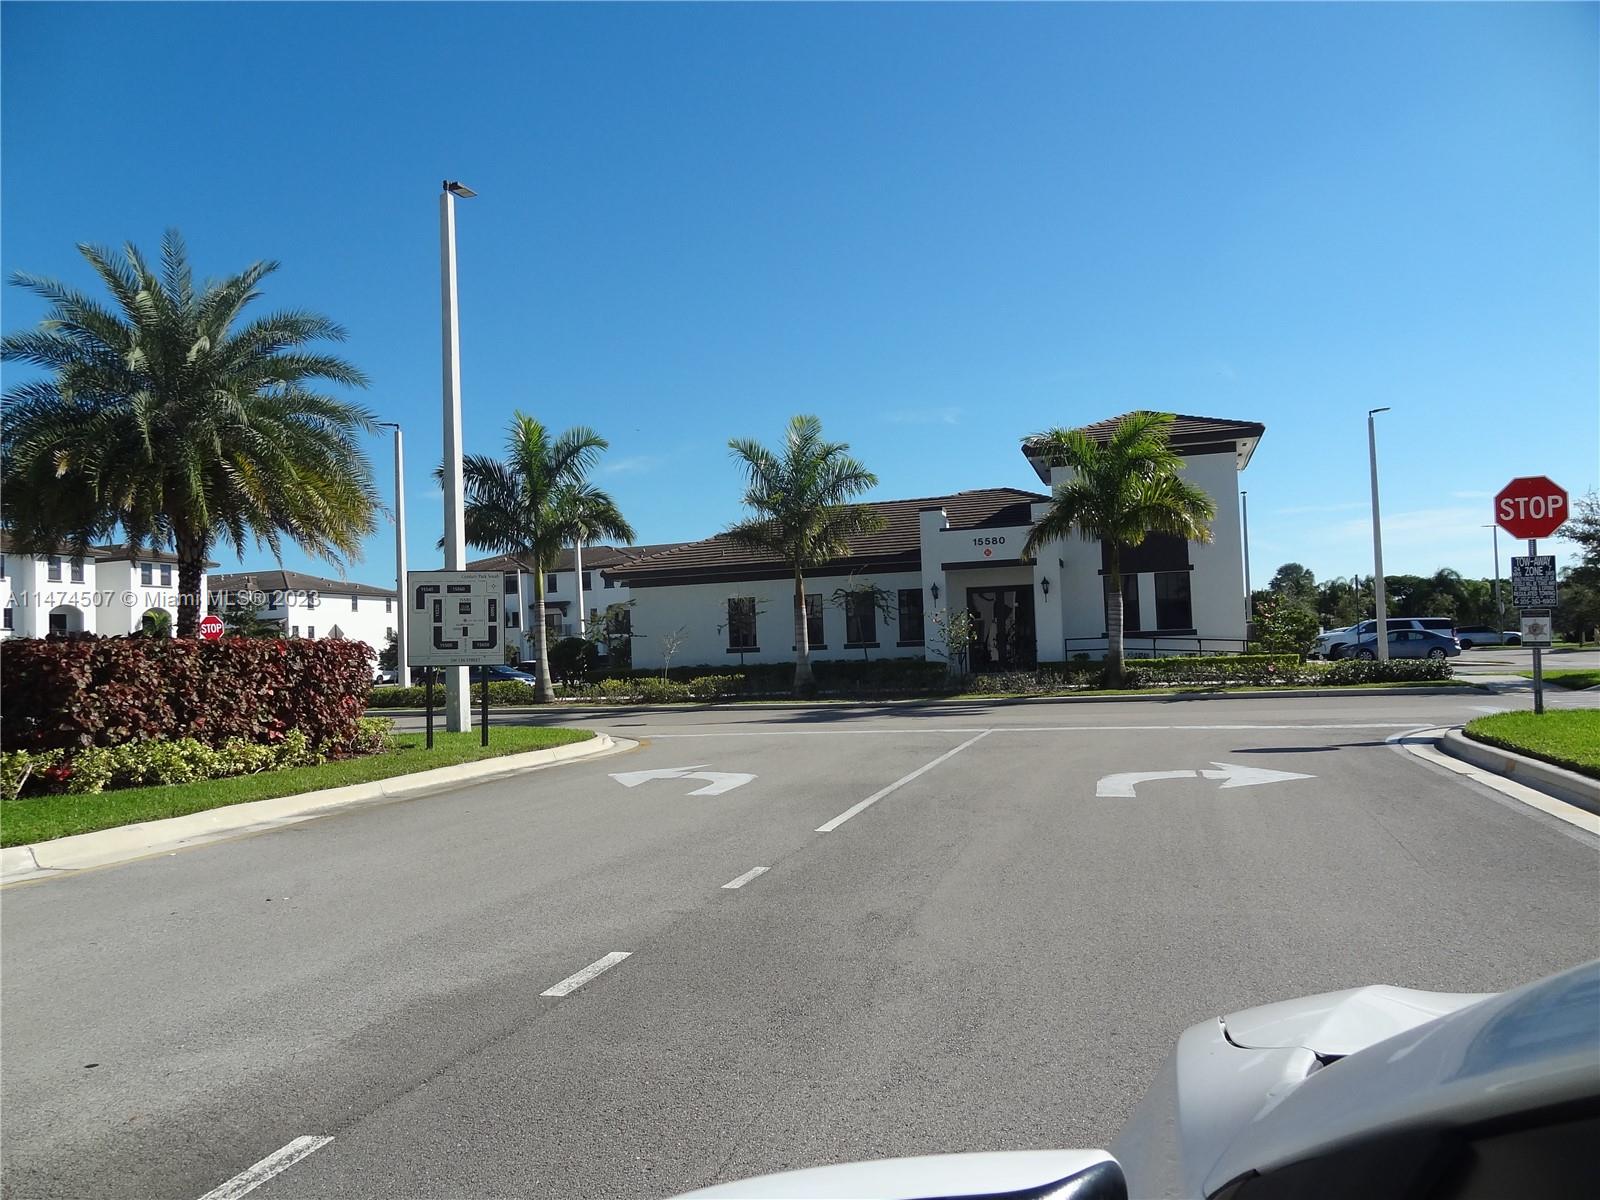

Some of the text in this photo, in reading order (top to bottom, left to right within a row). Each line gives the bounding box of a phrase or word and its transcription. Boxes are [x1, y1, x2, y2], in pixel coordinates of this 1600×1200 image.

[1500, 495, 1563, 520] STOP
[973, 536, 1006, 546] 15580
[1516, 557, 1551, 567] TOW-AWAY
[1525, 566, 1544, 576] ZONE
[201, 623, 222, 634] STOP
